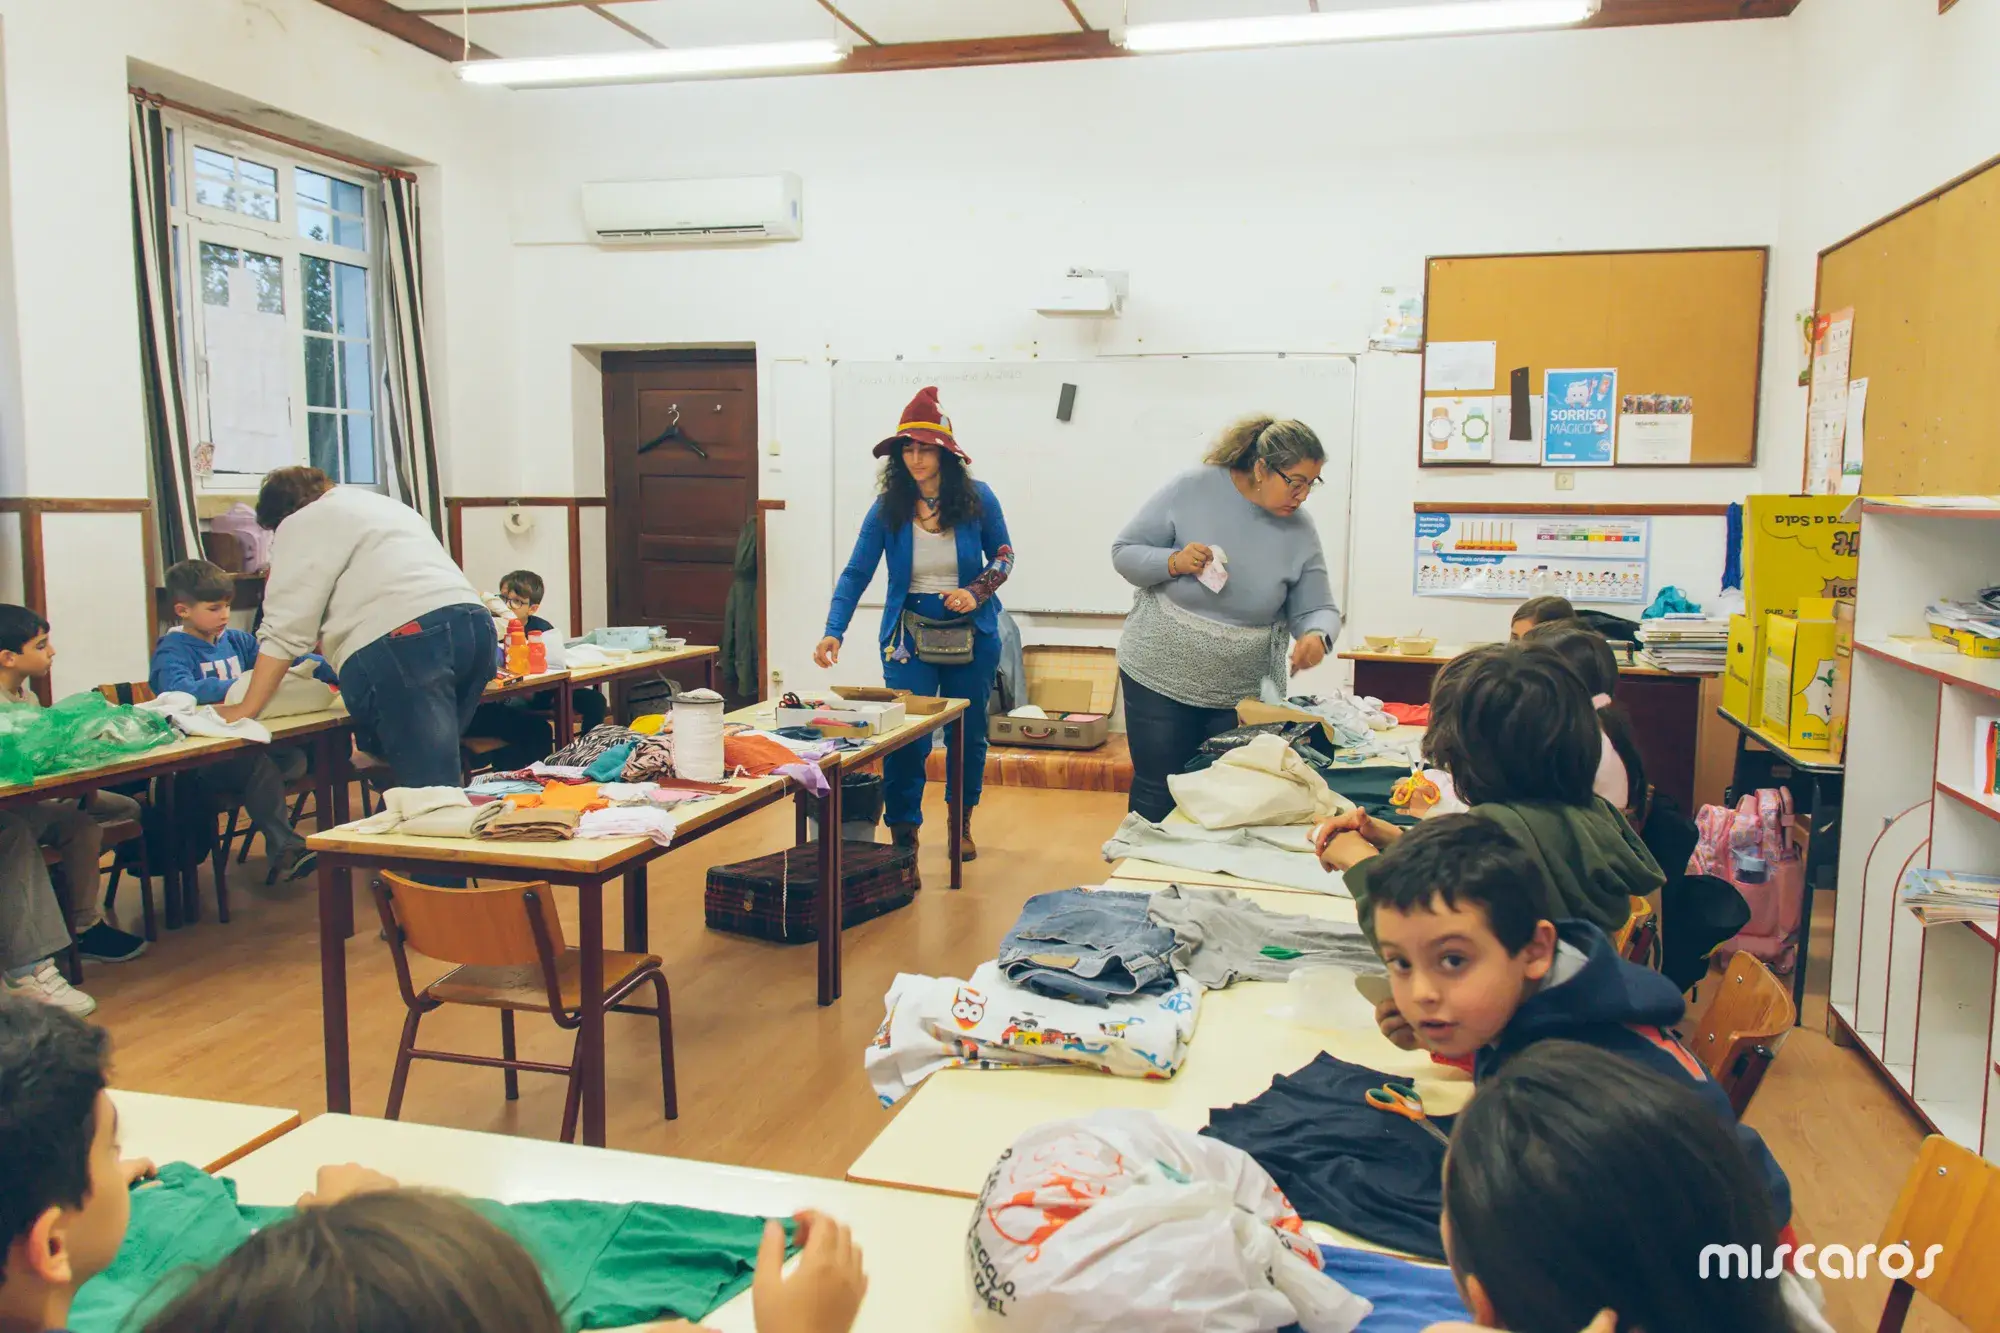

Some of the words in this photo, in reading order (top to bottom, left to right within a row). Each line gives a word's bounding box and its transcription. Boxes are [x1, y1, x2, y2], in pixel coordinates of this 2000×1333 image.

[1550, 409, 1607, 421] SORRISO
[1549, 421, 1592, 434] MÁGICO
[1775, 515, 1810, 527] Sala
[1814, 515, 1824, 524] a
